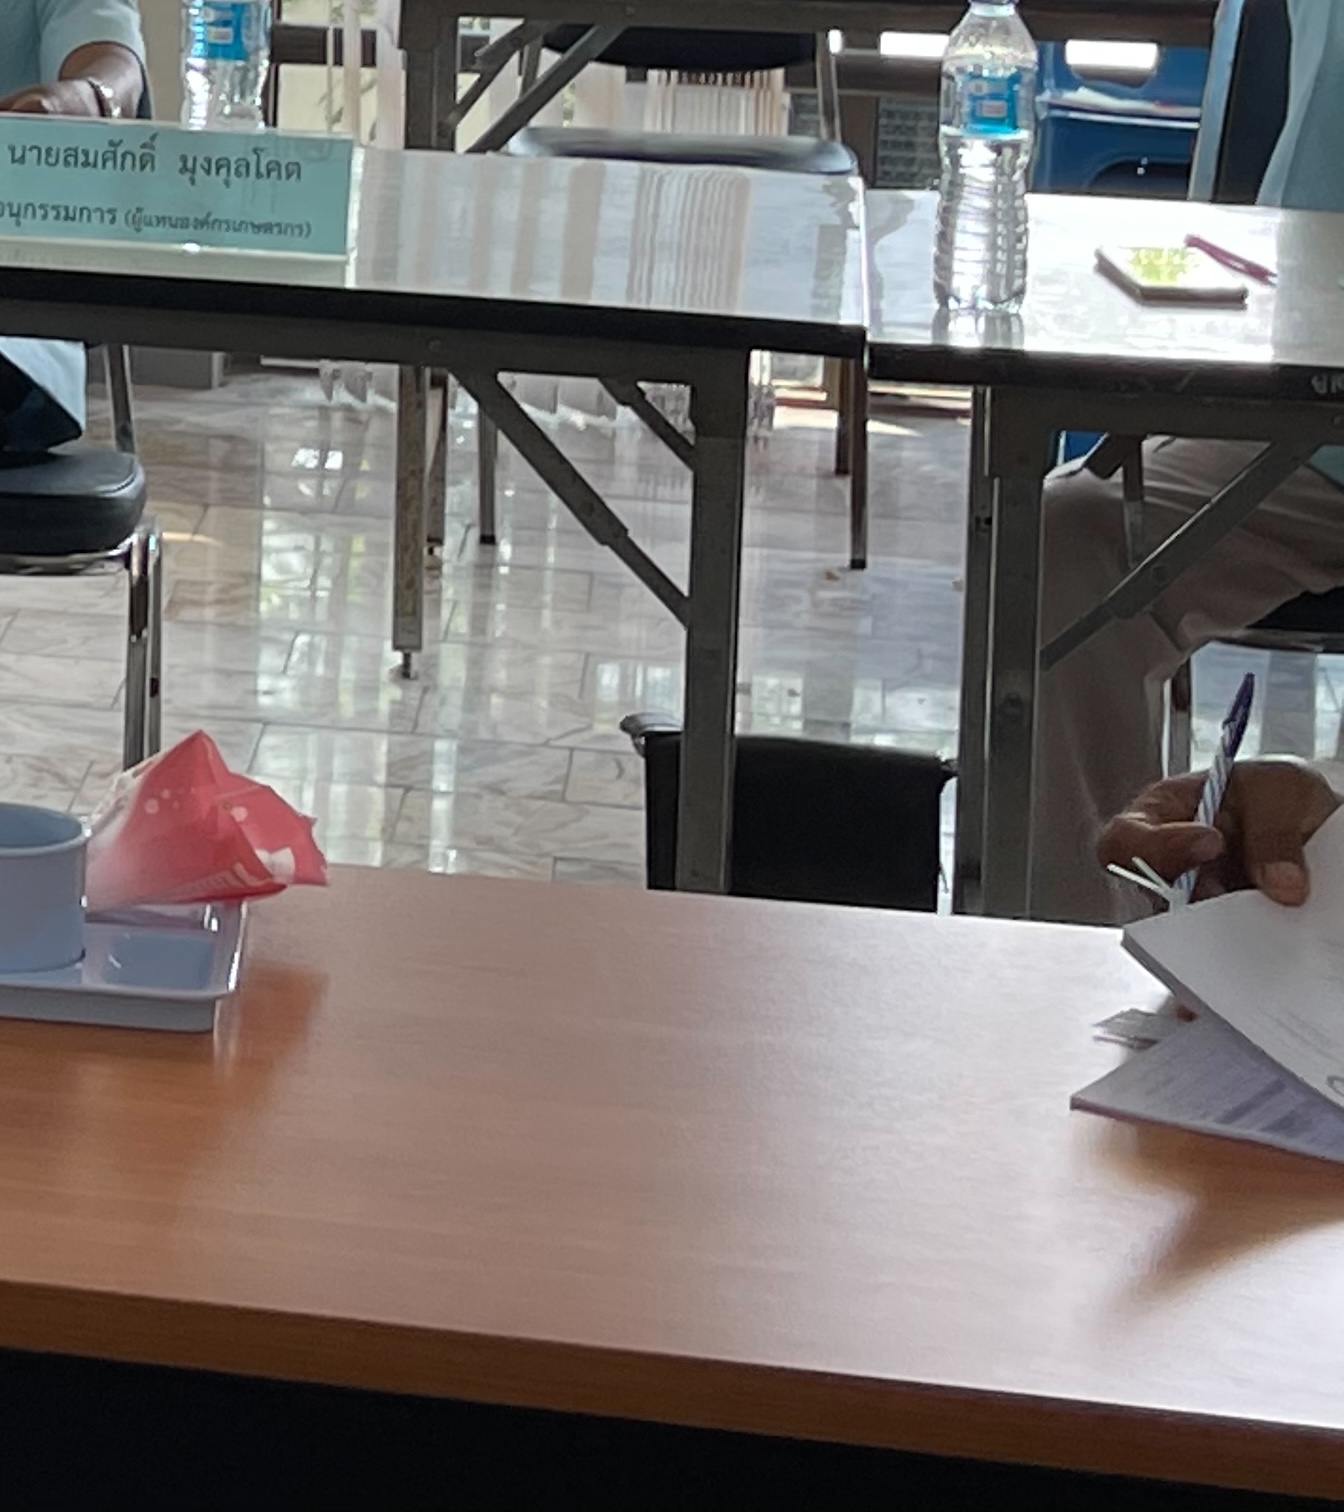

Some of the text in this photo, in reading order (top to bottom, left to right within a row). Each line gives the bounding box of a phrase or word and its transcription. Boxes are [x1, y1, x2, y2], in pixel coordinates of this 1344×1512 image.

[7, 132, 159, 173] นายสมศักดิ์
